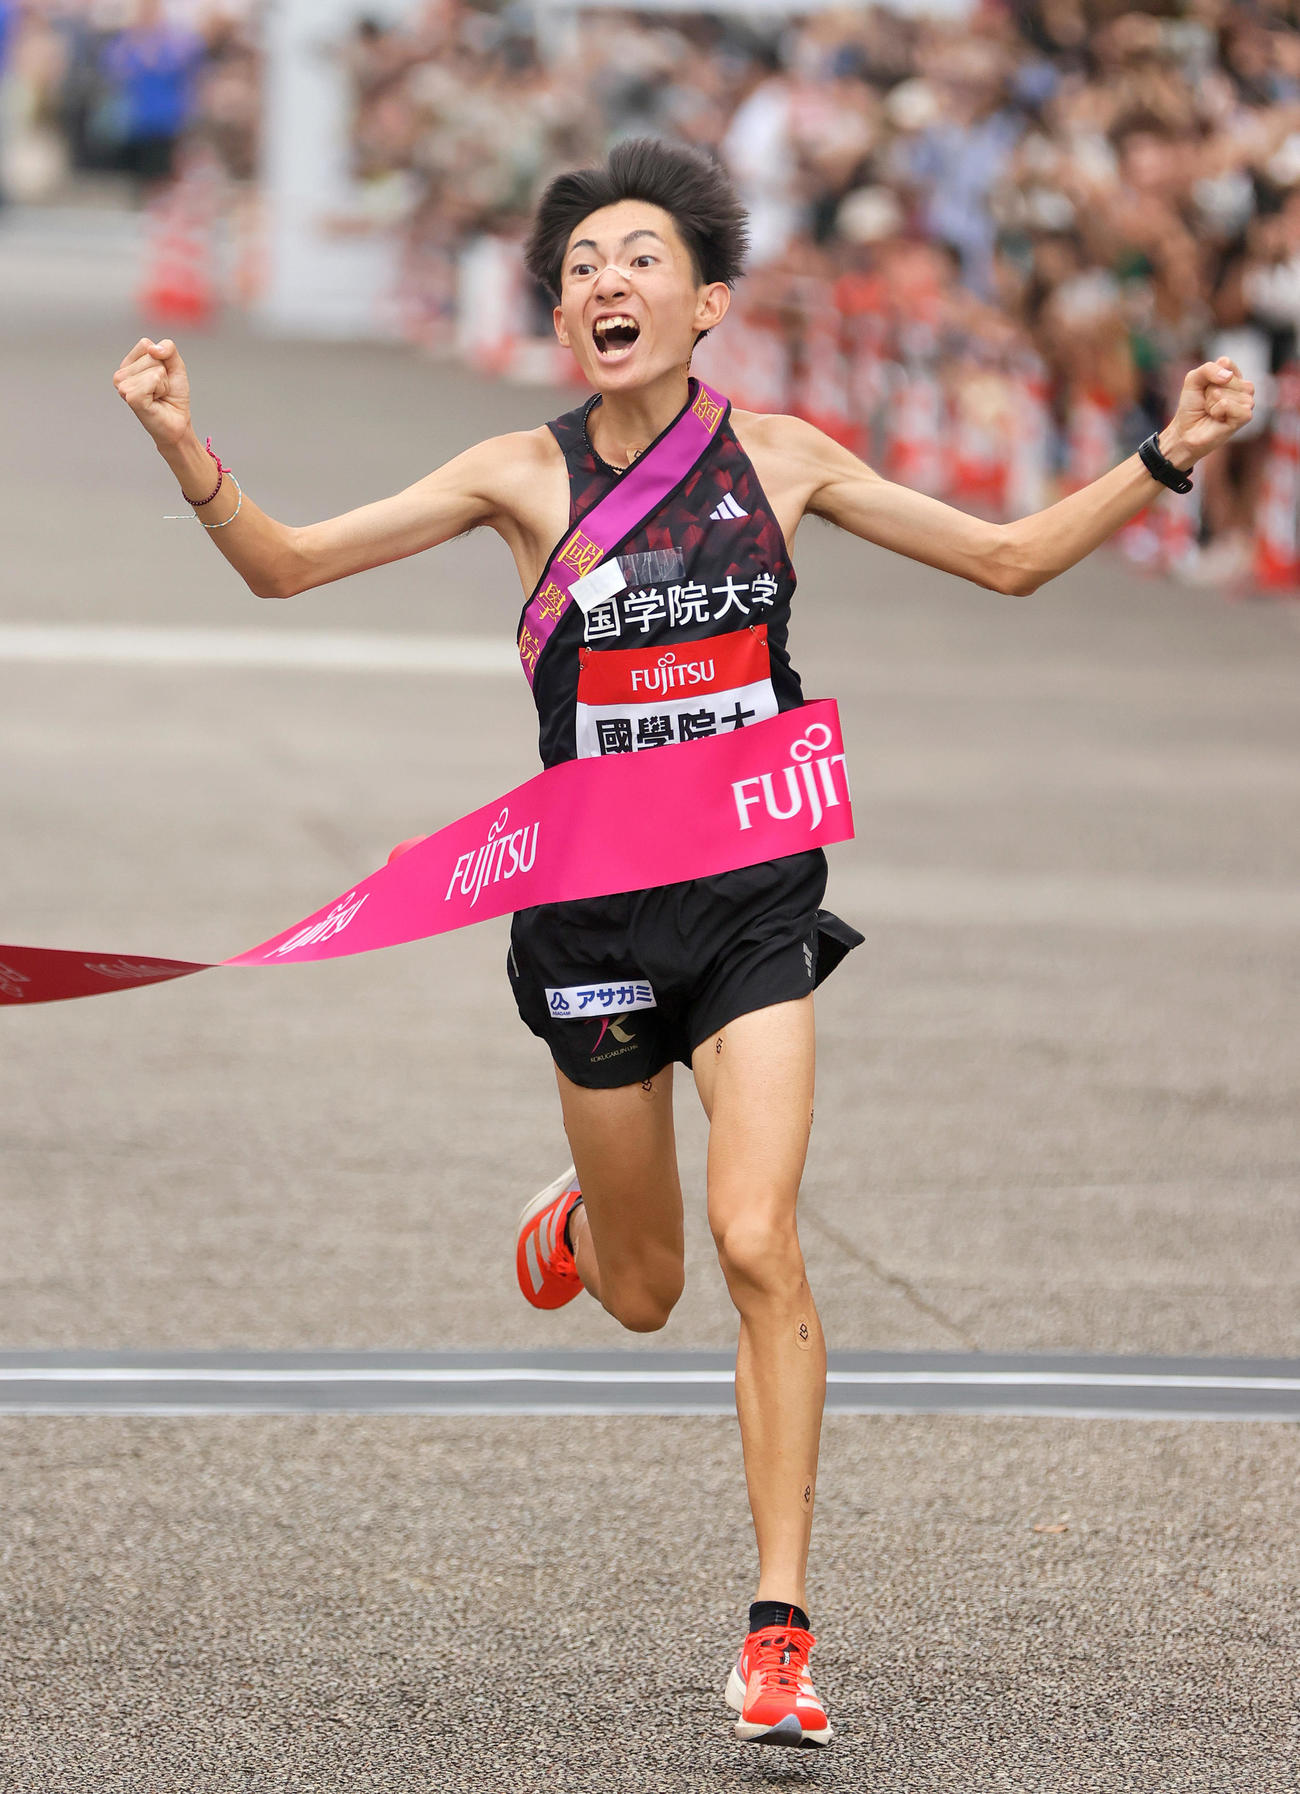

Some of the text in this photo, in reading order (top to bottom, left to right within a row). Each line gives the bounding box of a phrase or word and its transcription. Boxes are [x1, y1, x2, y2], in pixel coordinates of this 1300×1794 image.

[583, 572, 779, 643] 国学院大学
[631, 658, 716, 696] FUJITSU
[595, 701, 756, 756] 國學院大
[444, 821, 540, 908] FUJITSU
[576, 985, 653, 1010] アサガミ
